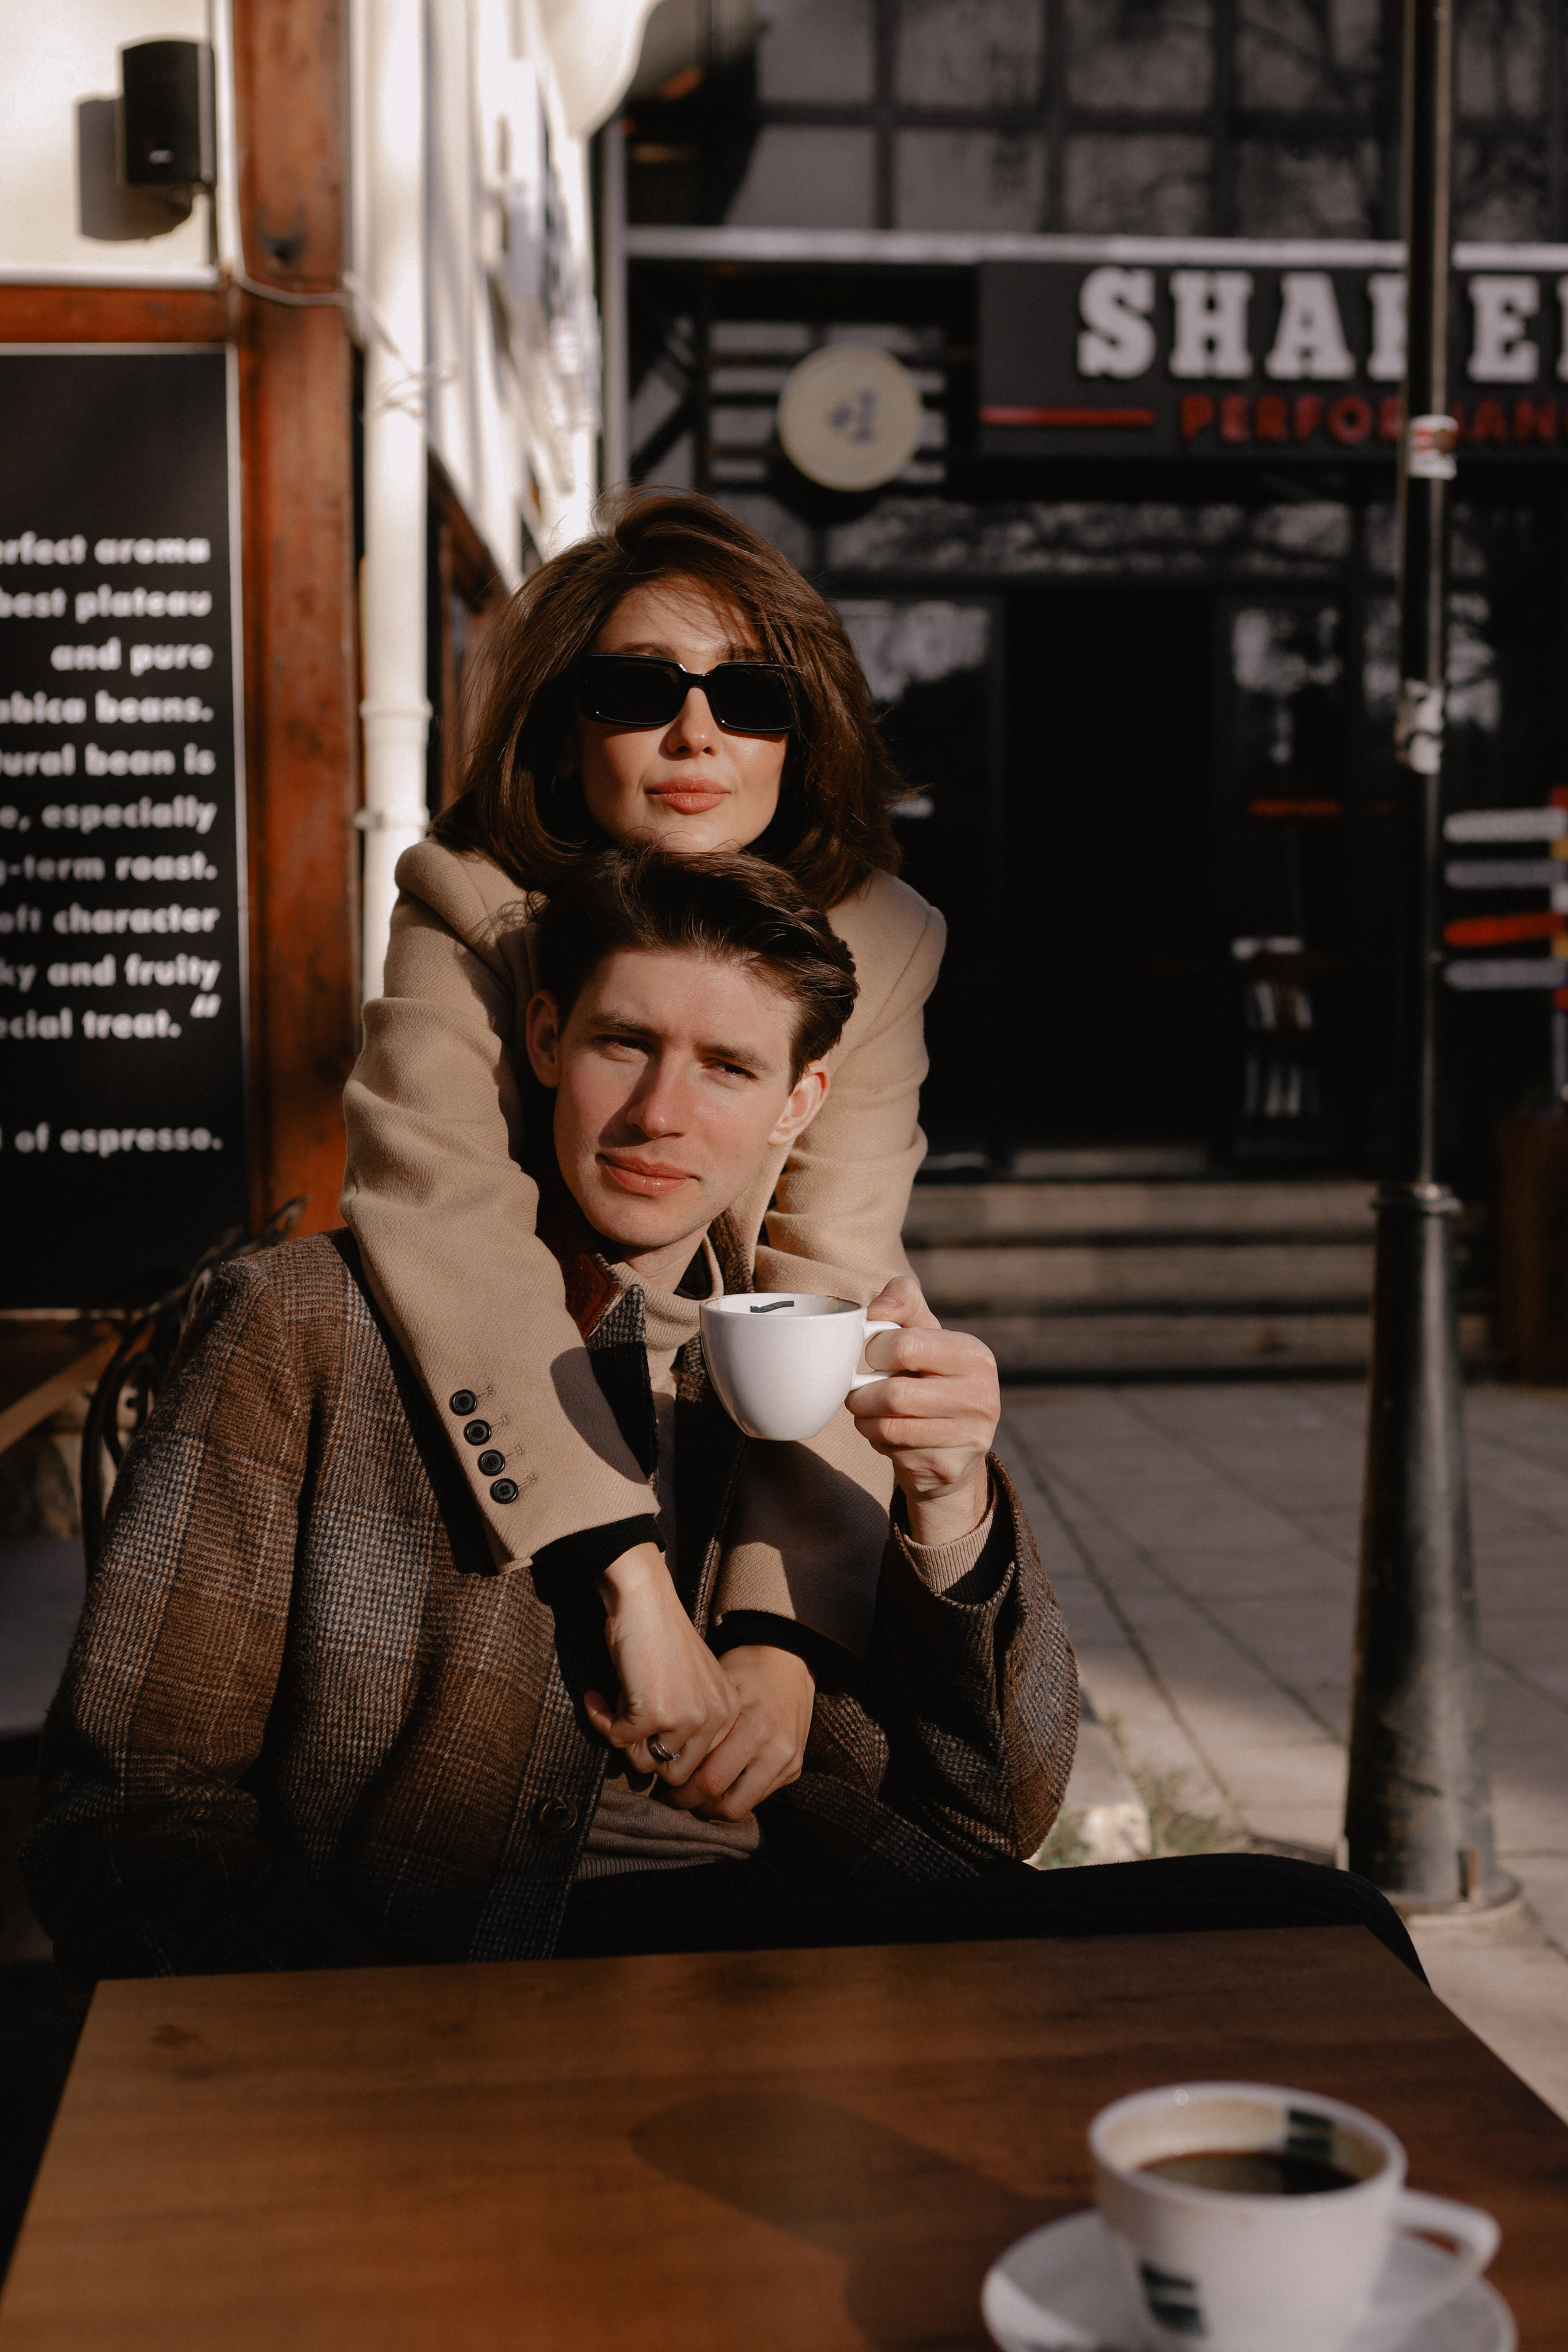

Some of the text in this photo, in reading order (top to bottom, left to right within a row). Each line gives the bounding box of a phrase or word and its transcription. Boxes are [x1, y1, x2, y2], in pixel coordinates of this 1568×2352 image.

[1076, 265, 1568, 384] SHAE
[1180, 393, 1568, 450] PERFORAN
[0, 530, 211, 565] rfect aroma
[75, 583, 213, 624] plateau
[50, 636, 213, 677] and pure
[95, 689, 214, 723] beans.
[0, 742, 216, 777] ural bean is
[42, 794, 217, 834] especially
[115, 850, 218, 881] roast.
[53, 903, 221, 934] character
[47, 953, 116, 987] and
[124, 952, 221, 992] fruity
[82, 1008, 182, 1039] treat.
[15, 1121, 50, 1153] of
[60, 1127, 222, 1158] espresso.
